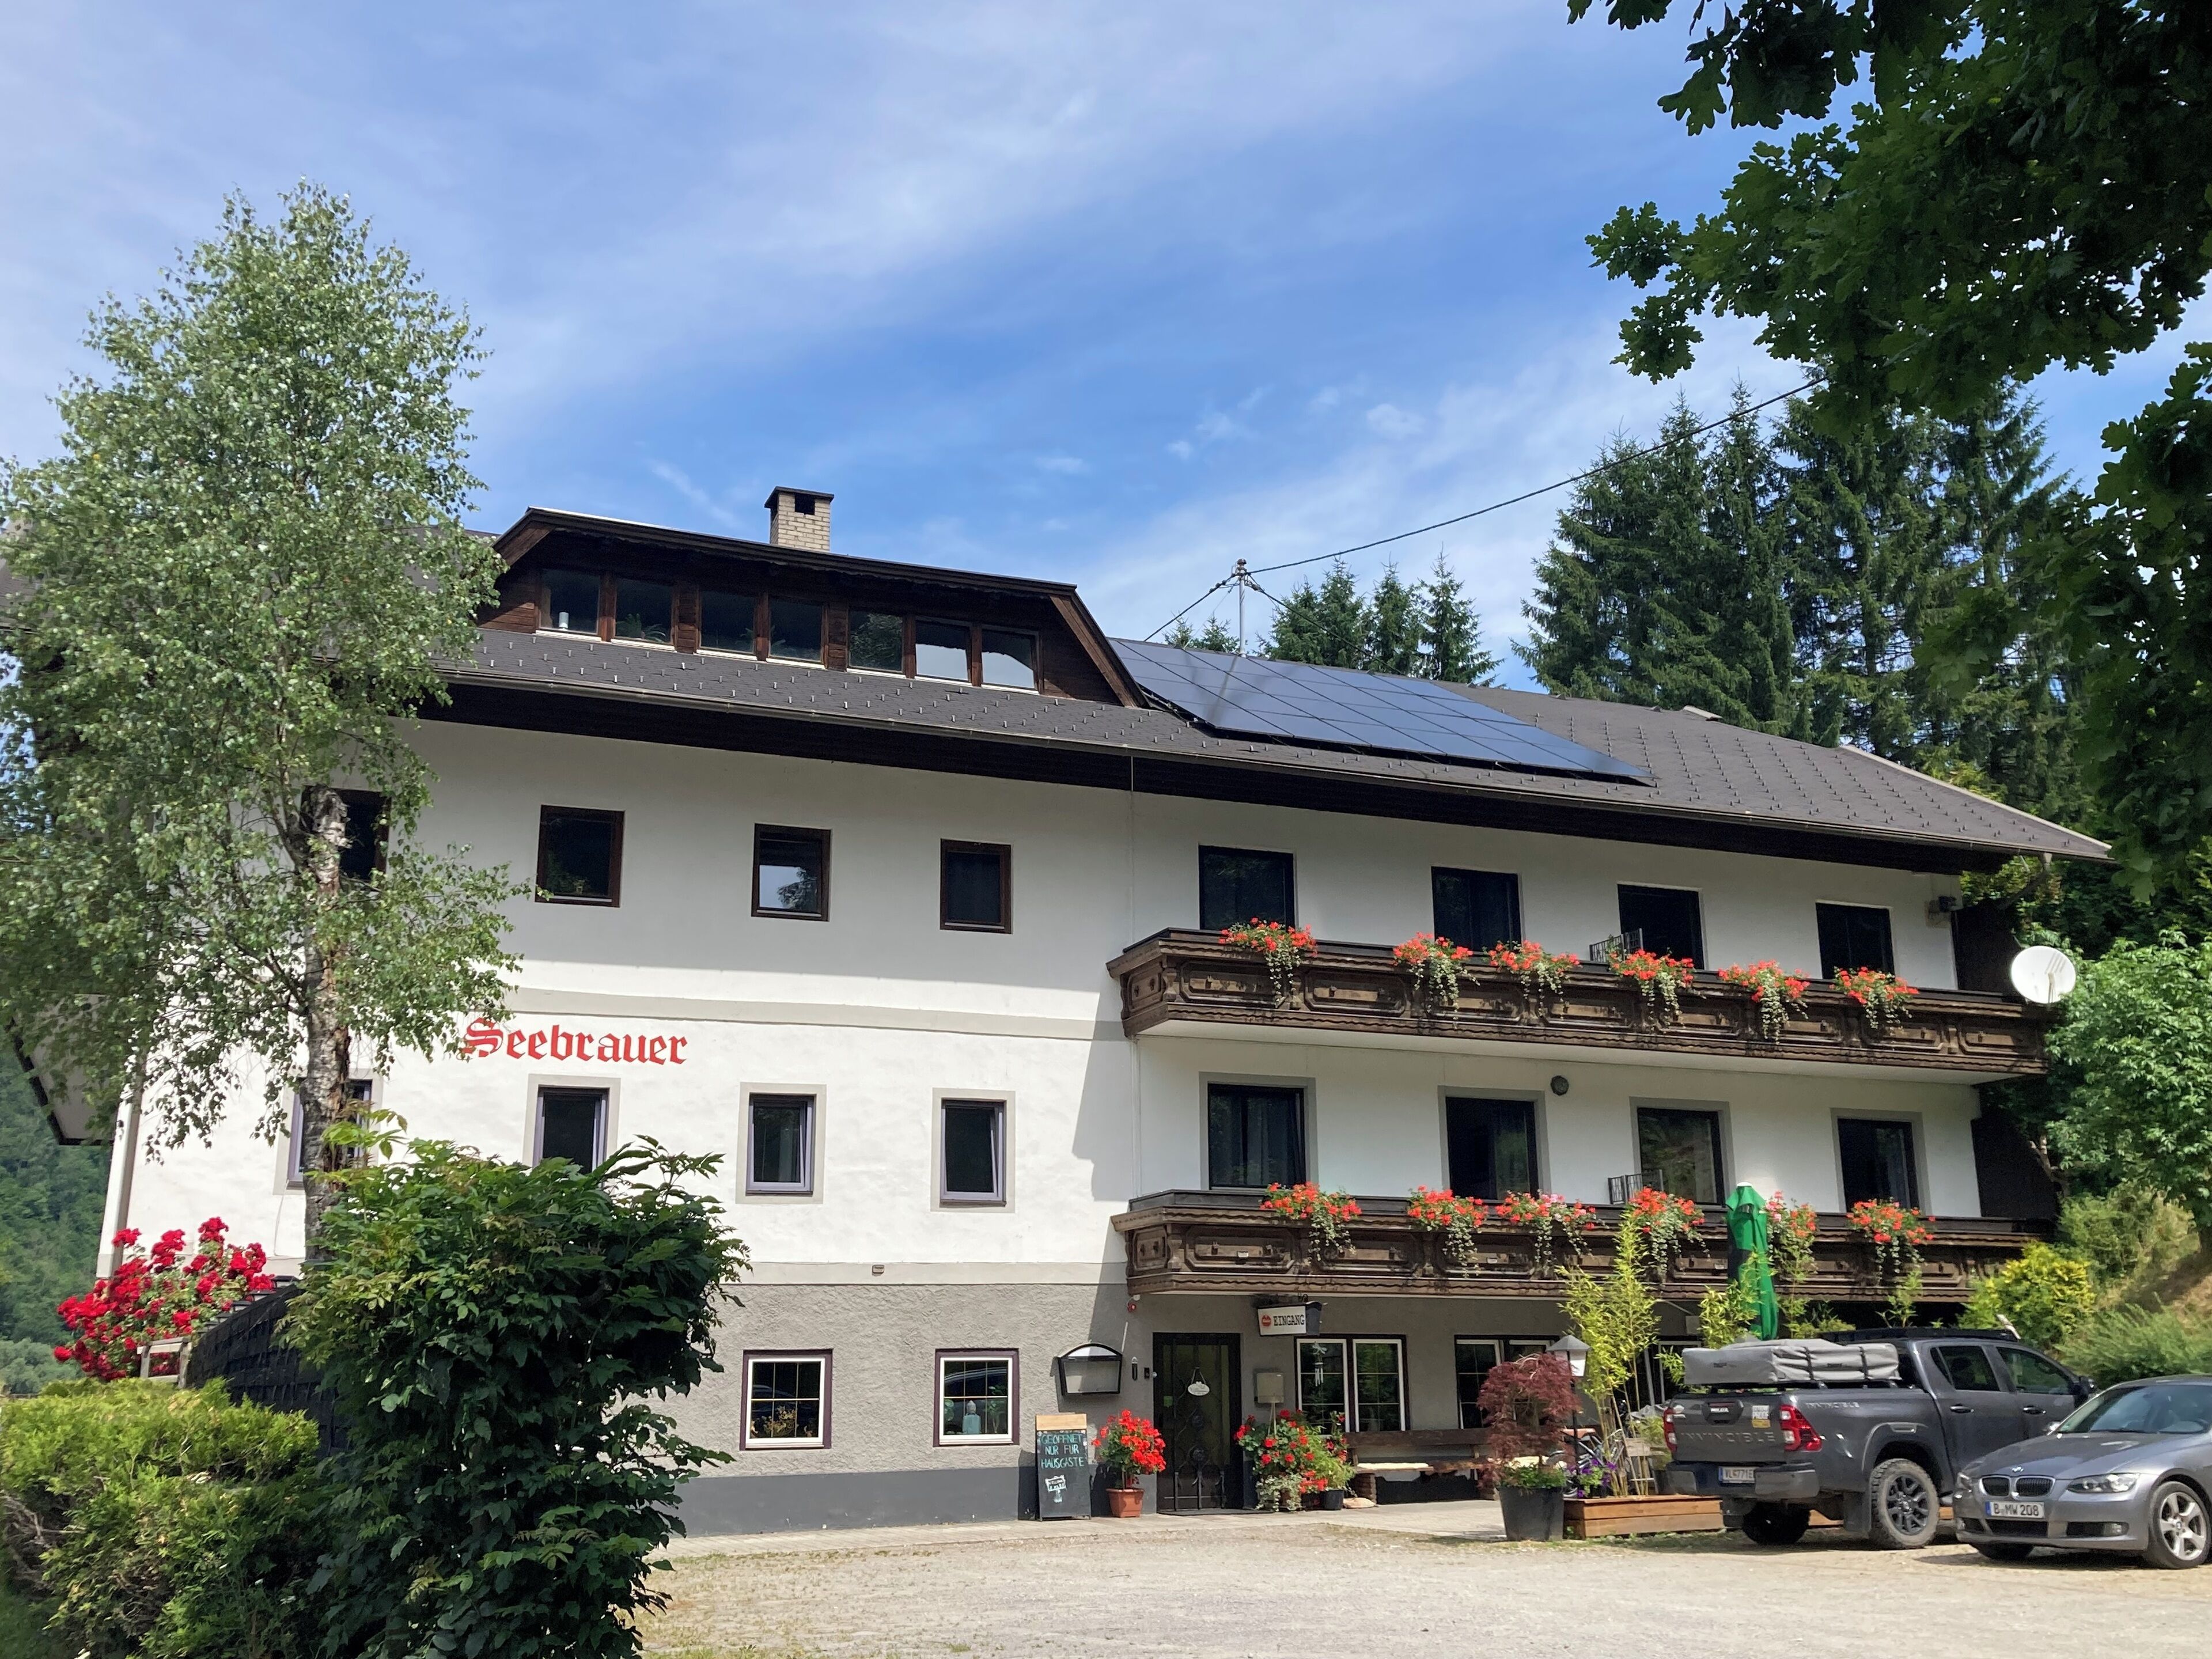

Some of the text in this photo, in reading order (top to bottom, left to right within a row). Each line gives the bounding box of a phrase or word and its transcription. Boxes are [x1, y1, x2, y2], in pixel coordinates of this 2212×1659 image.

[461, 1017, 688, 1066] Seebrauer
[1273, 1314, 1305, 1326] EINGANG
[1045, 1445, 1059, 1456] NUR
[1994, 1503, 2000, 1514] B
[2020, 1504, 2039, 1516] 208
